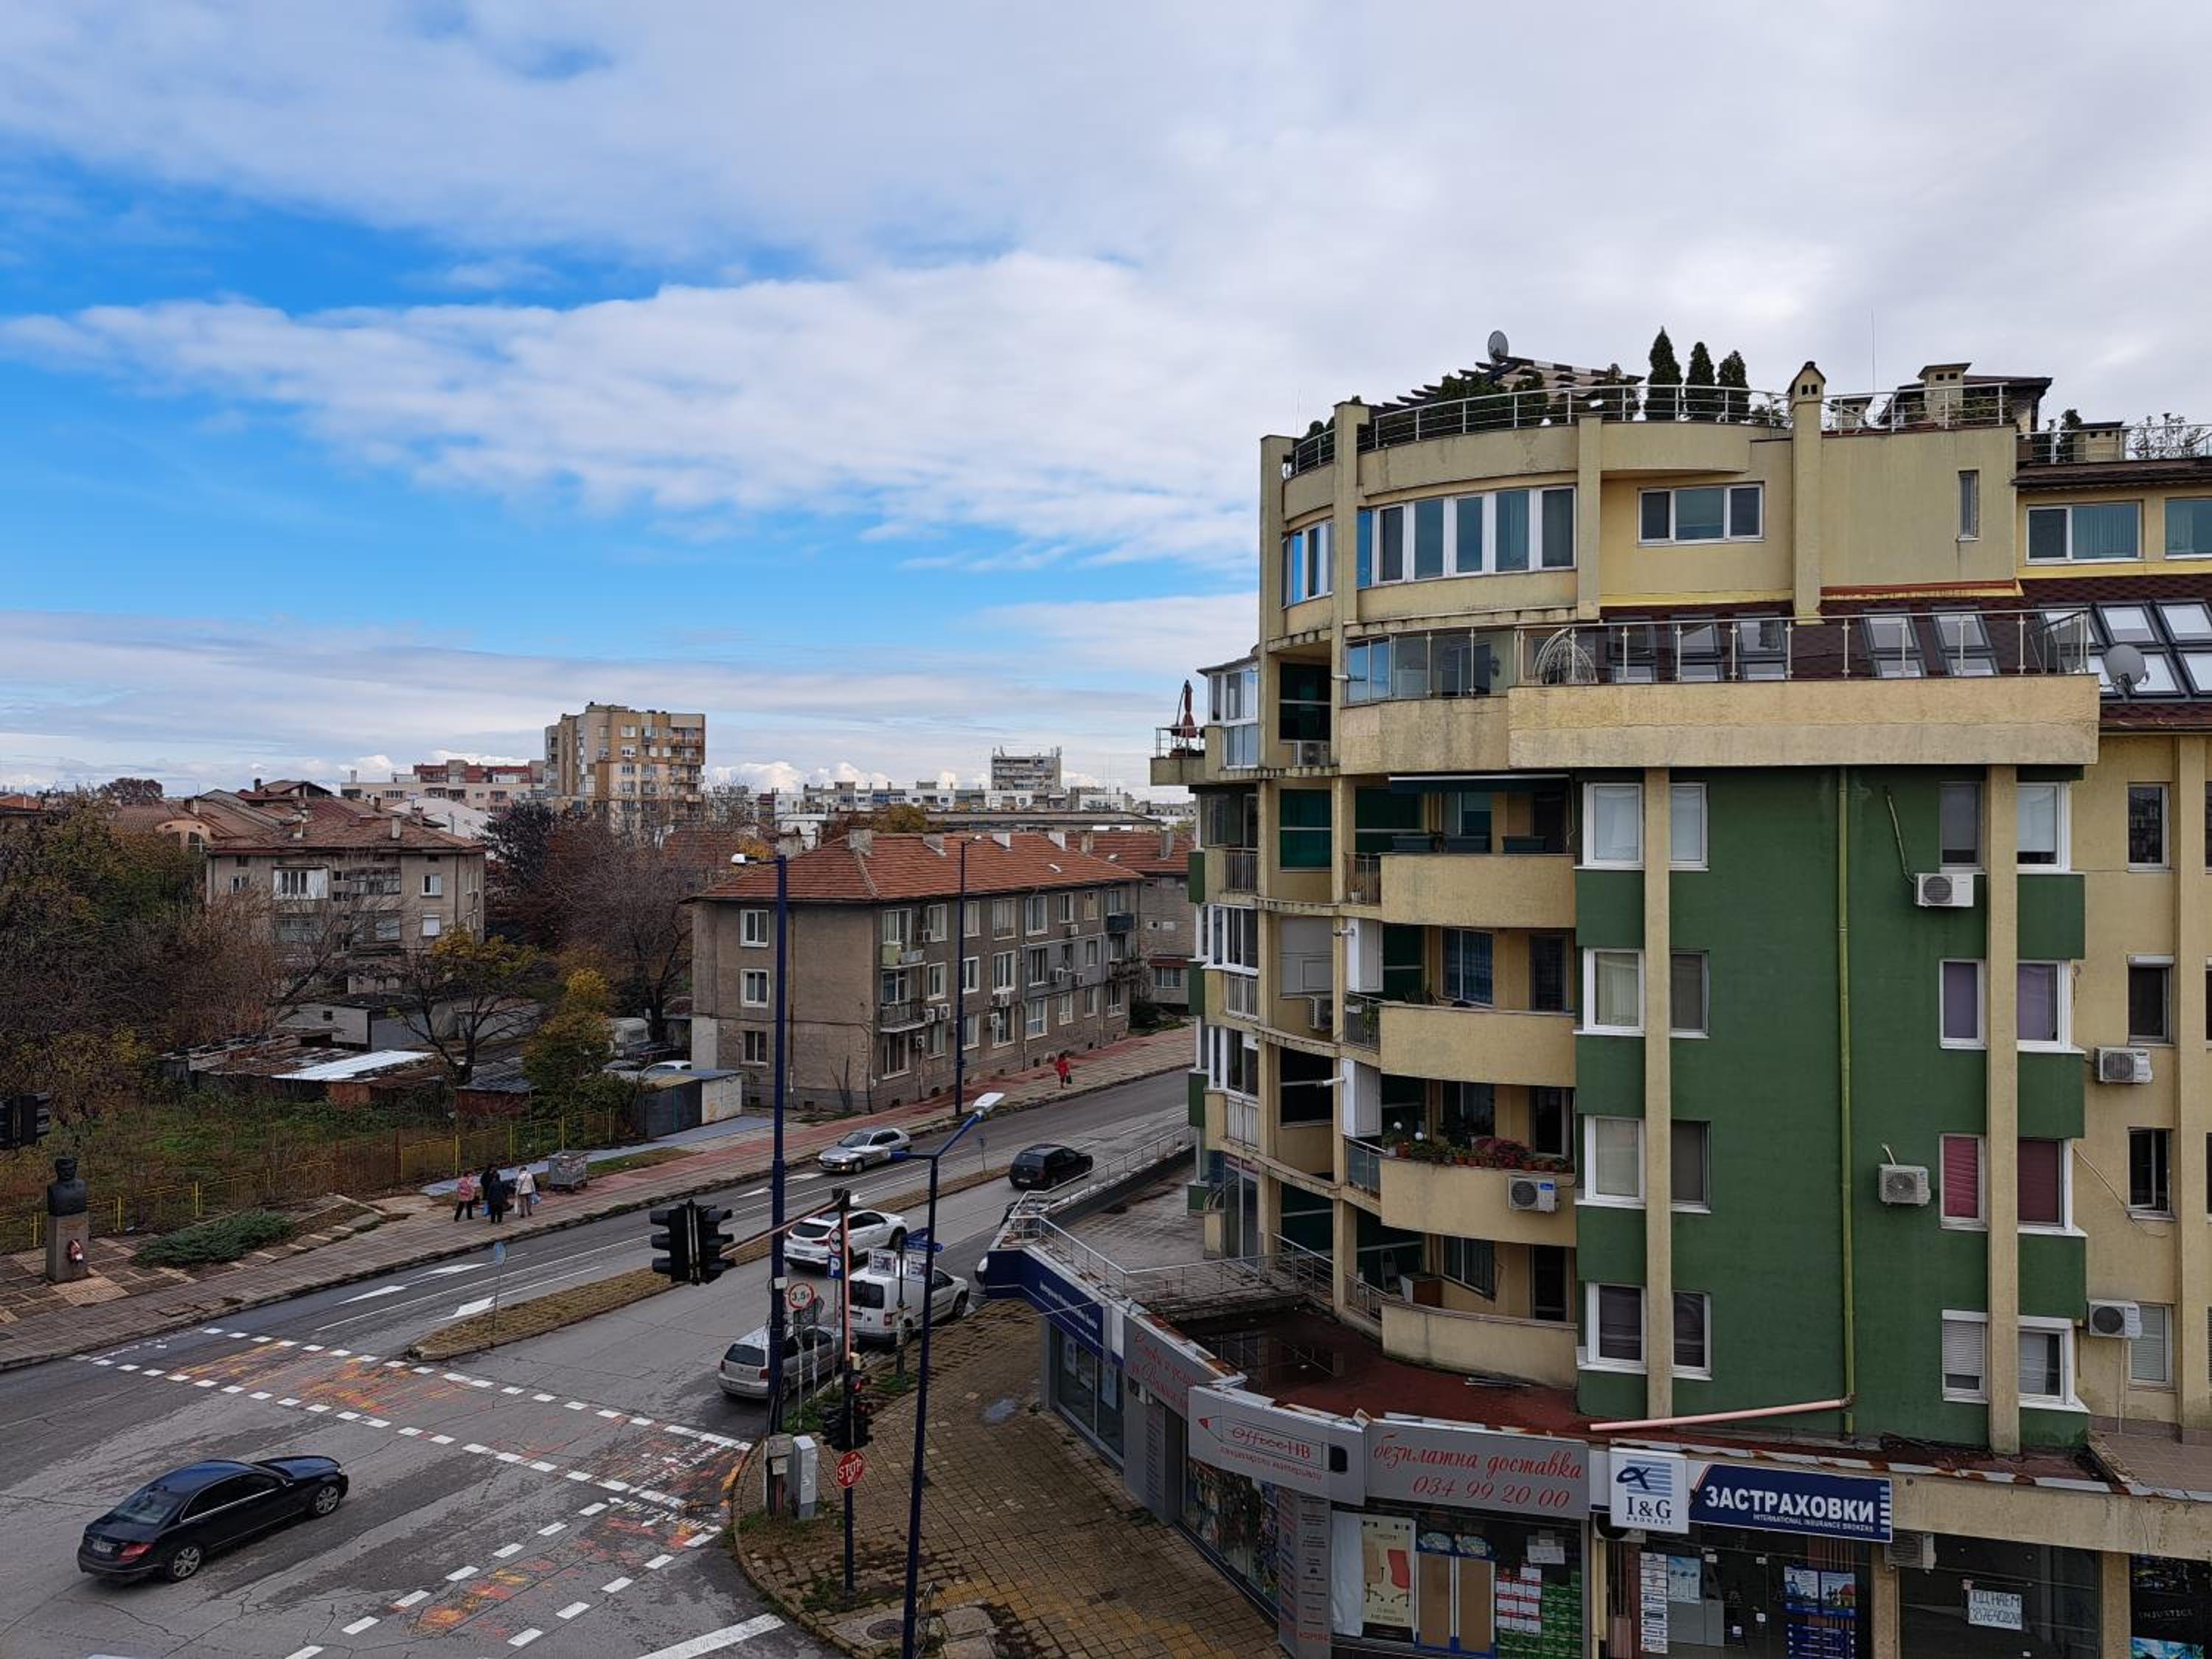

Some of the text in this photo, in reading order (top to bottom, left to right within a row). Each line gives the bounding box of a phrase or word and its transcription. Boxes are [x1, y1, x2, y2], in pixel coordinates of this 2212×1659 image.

[838, 1457, 862, 1480] STOP
[1374, 1434, 1582, 1479] безплатна доставка
[1413, 1475, 1570, 1509] 034 99 20 00
[1705, 1486, 1874, 1523] ЗАСТРАХОВКИ
[1753, 1514, 1874, 1533] INTERNATIONAL INSURANCE BROKERS
